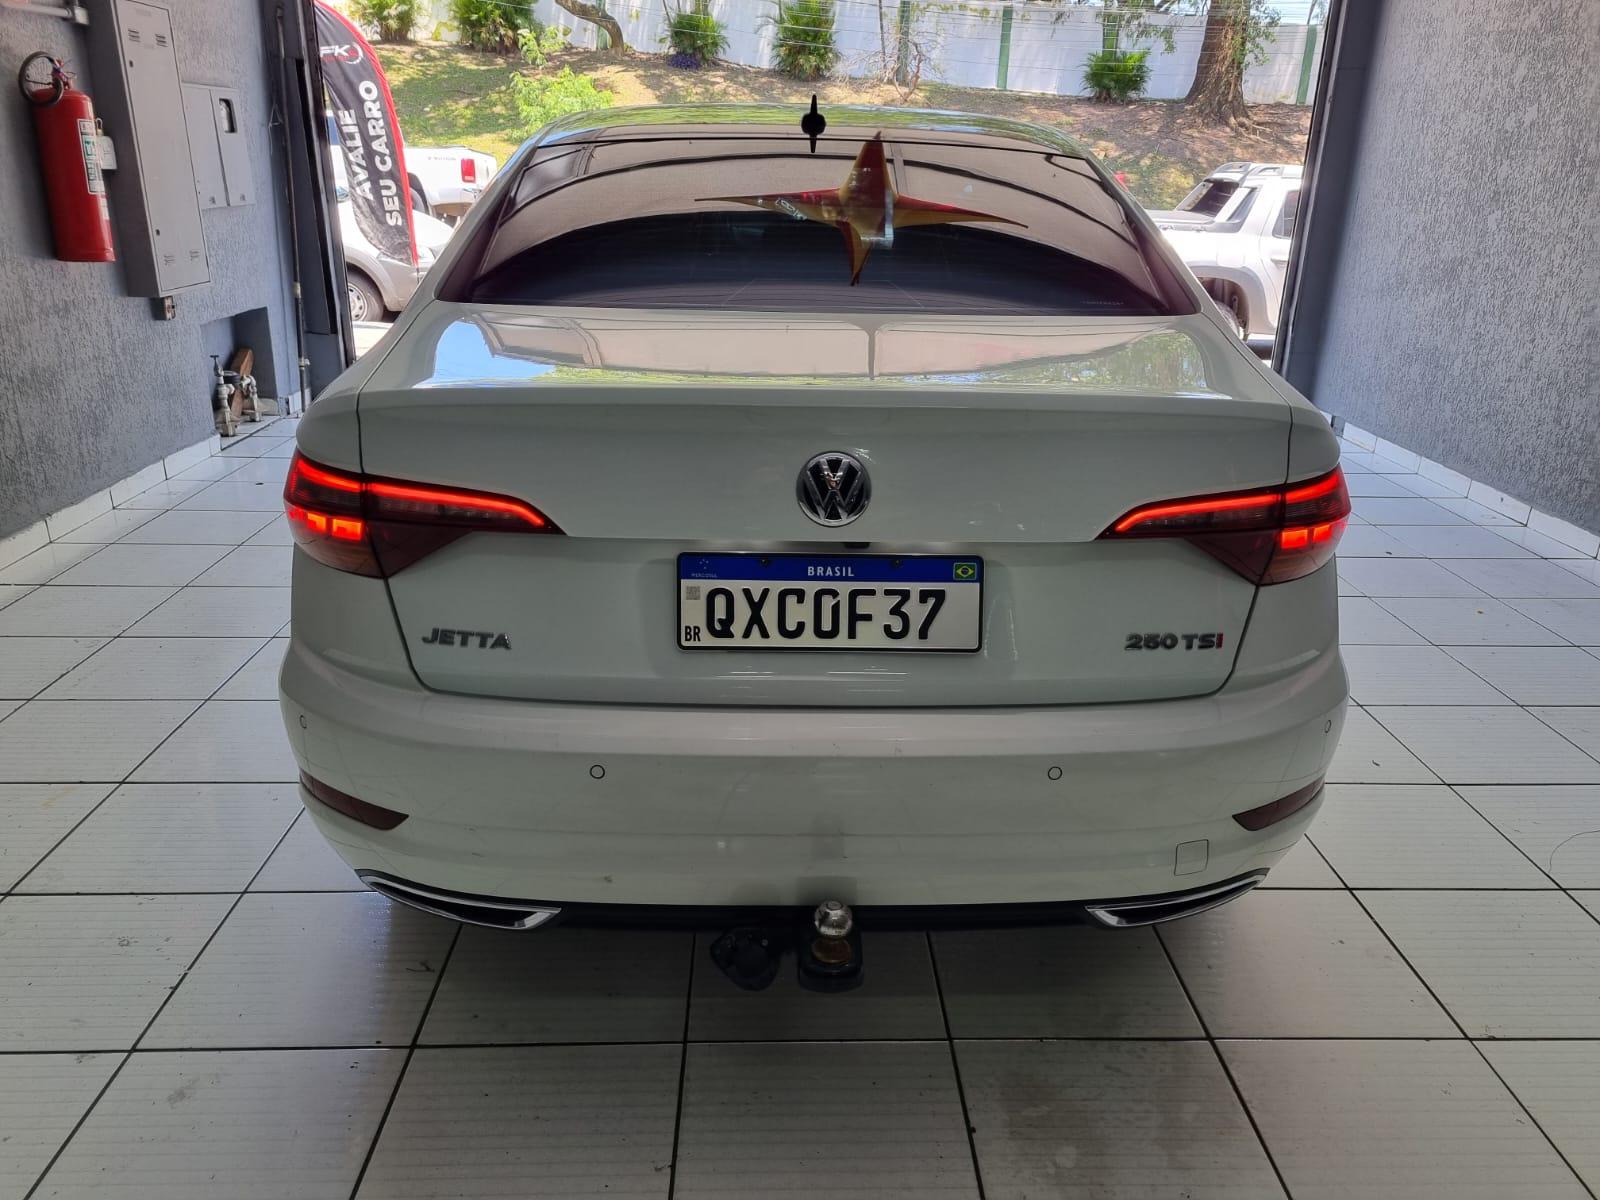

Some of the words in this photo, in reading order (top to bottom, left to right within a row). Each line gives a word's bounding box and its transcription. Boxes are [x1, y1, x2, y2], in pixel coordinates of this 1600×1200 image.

[358, 80, 392, 172] CARRO
[338, 109, 374, 200] AVALIE
[379, 178, 402, 226] SEU
[807, 566, 855, 577] BRASIL
[421, 627, 512, 650] JETTA
[684, 625, 701, 642] BR
[1124, 633, 1179, 651] 250
[1181, 633, 1224, 650] TSI
